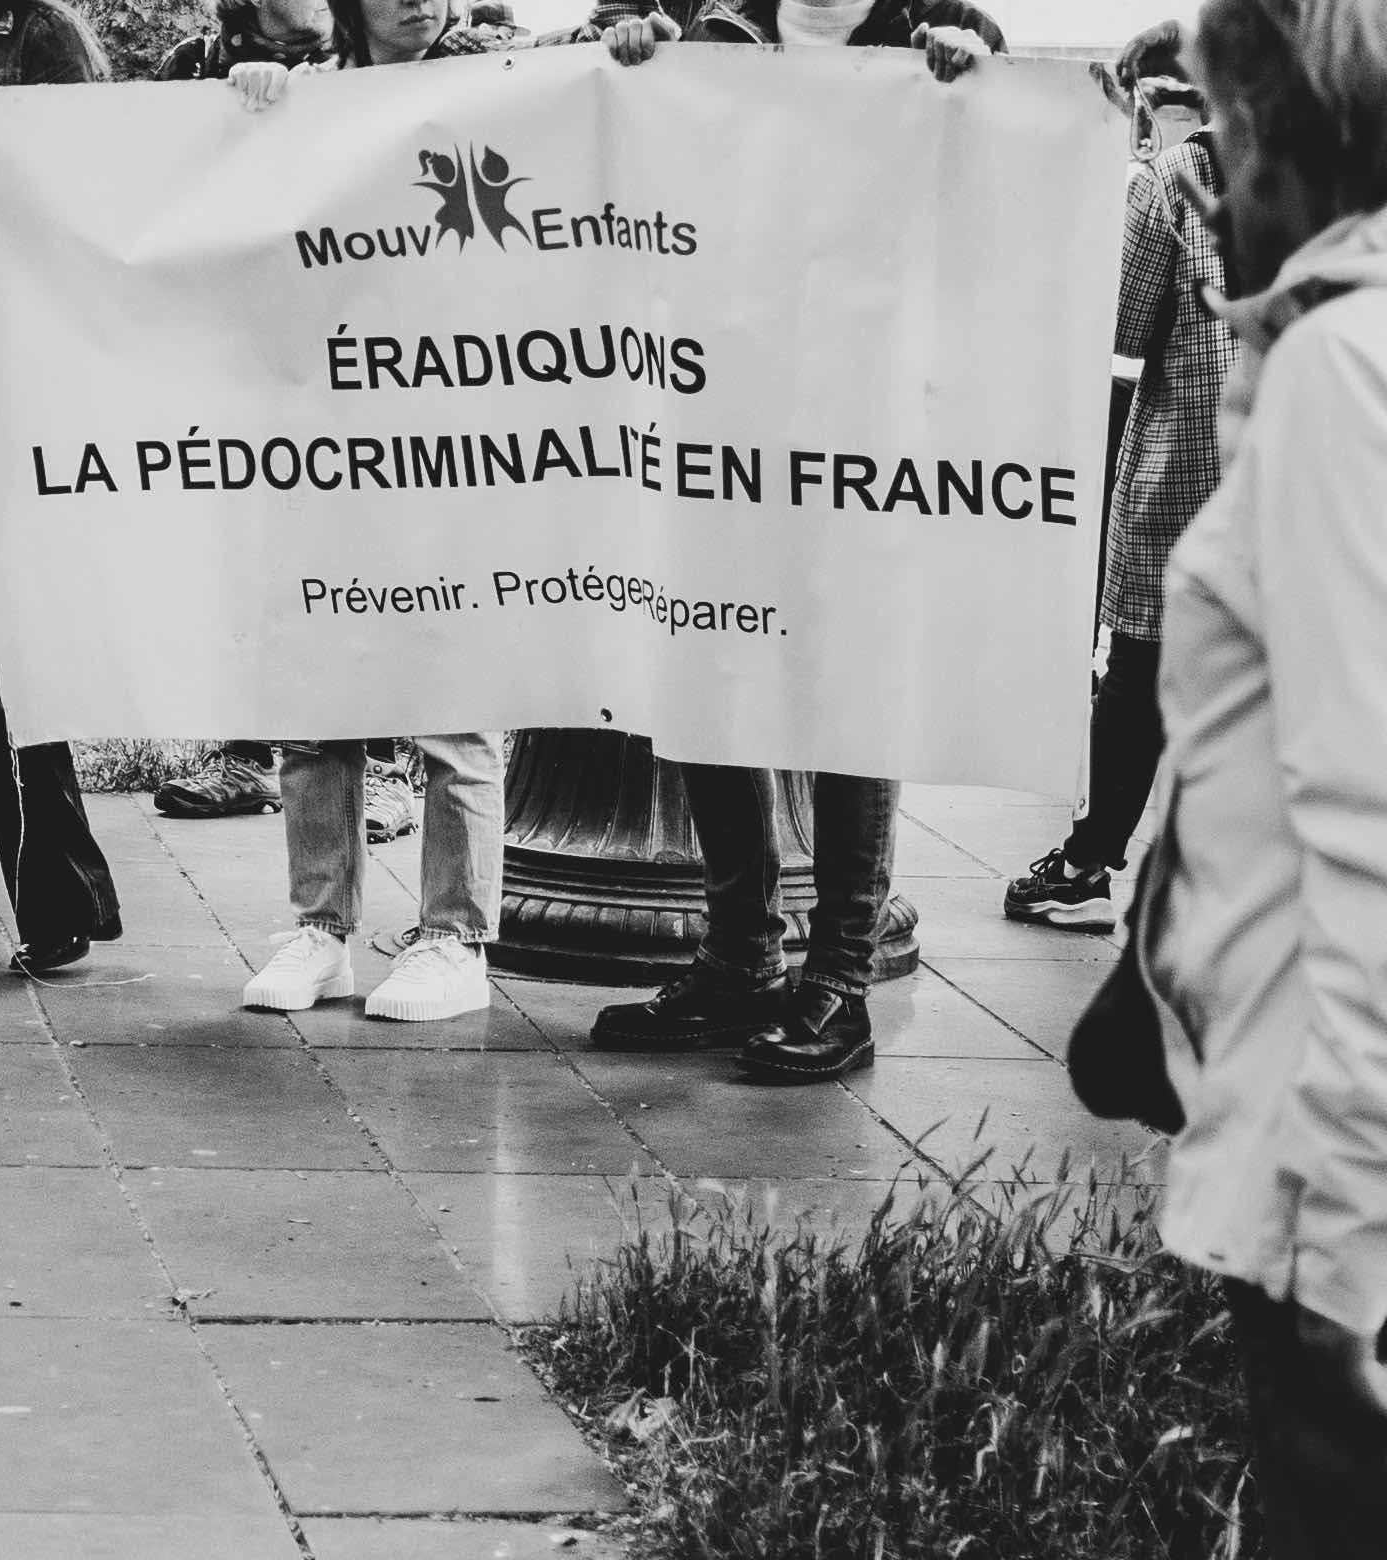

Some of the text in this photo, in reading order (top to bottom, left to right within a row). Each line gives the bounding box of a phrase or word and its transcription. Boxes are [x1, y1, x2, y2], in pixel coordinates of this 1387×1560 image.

[296, 201, 698, 269] Mouv Enfants
[327, 324, 707, 395] ÉRADIQUONS
[32, 442, 117, 496] LA
[675, 443, 761, 504] EN
[789, 450, 1077, 527] FRANCE
[302, 575, 479, 616] Prévenir.
[642, 579, 788, 636] Réparer.
